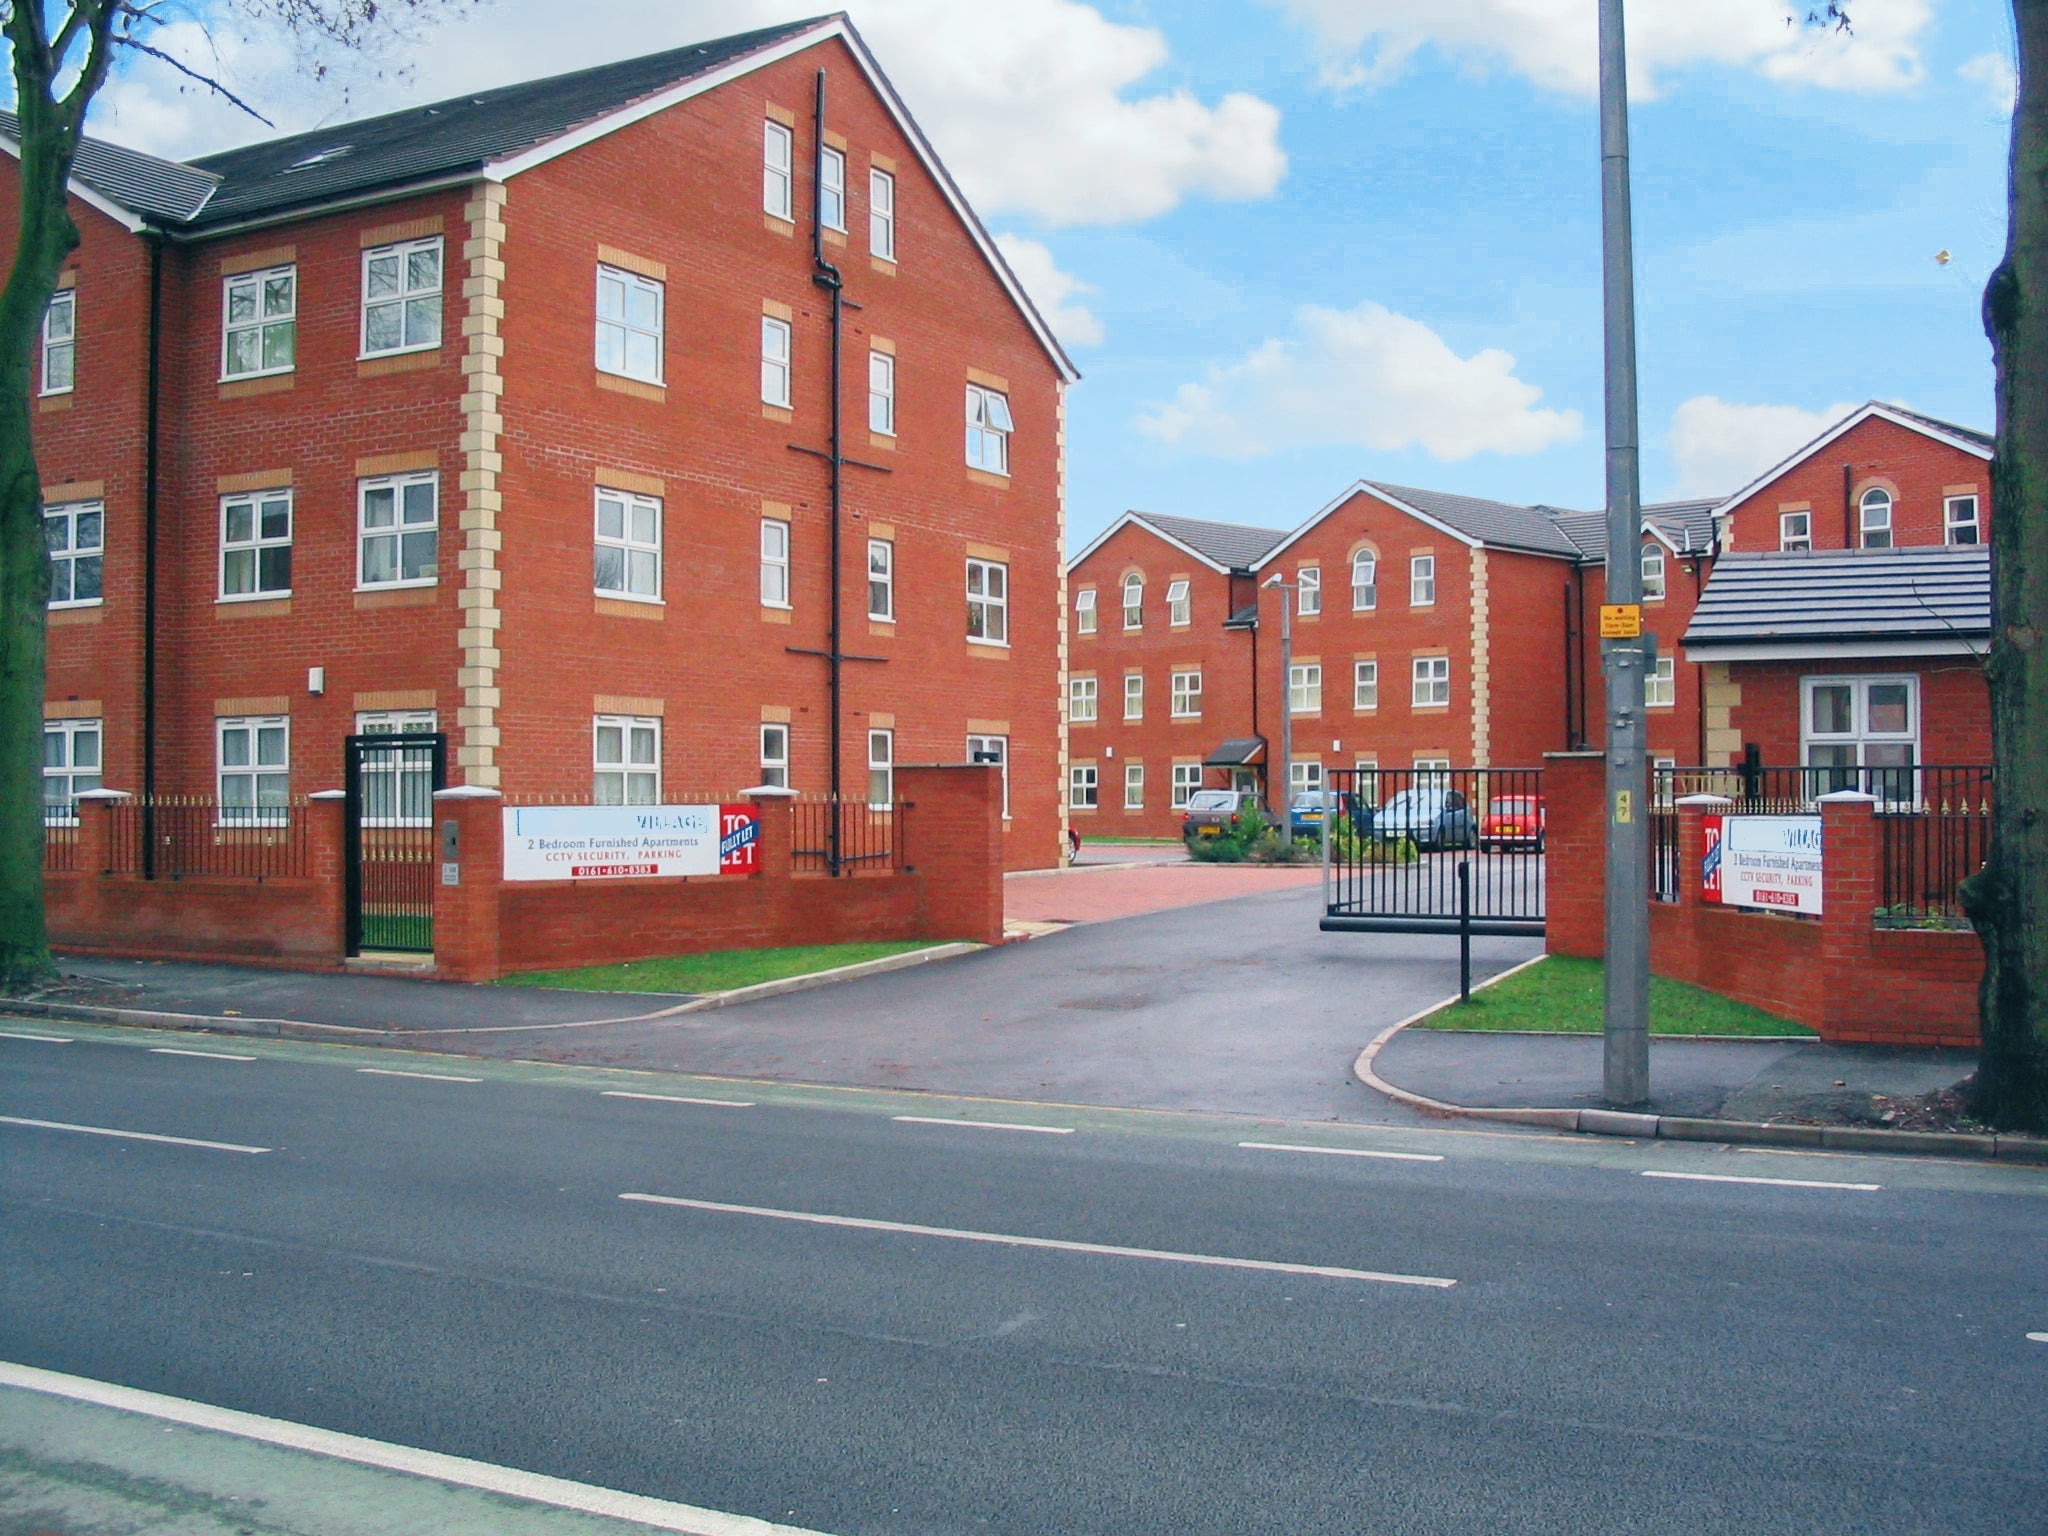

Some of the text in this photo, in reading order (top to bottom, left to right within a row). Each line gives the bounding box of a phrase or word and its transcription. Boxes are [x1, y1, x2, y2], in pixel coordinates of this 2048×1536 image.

[723, 814, 751, 836] TO
[527, 837, 699, 850] 2 Bedroom Furnished Apartments
[545, 850, 682, 862] CCTV SECURITY, PARKING
[1786, 874, 1813, 887] PARKING
